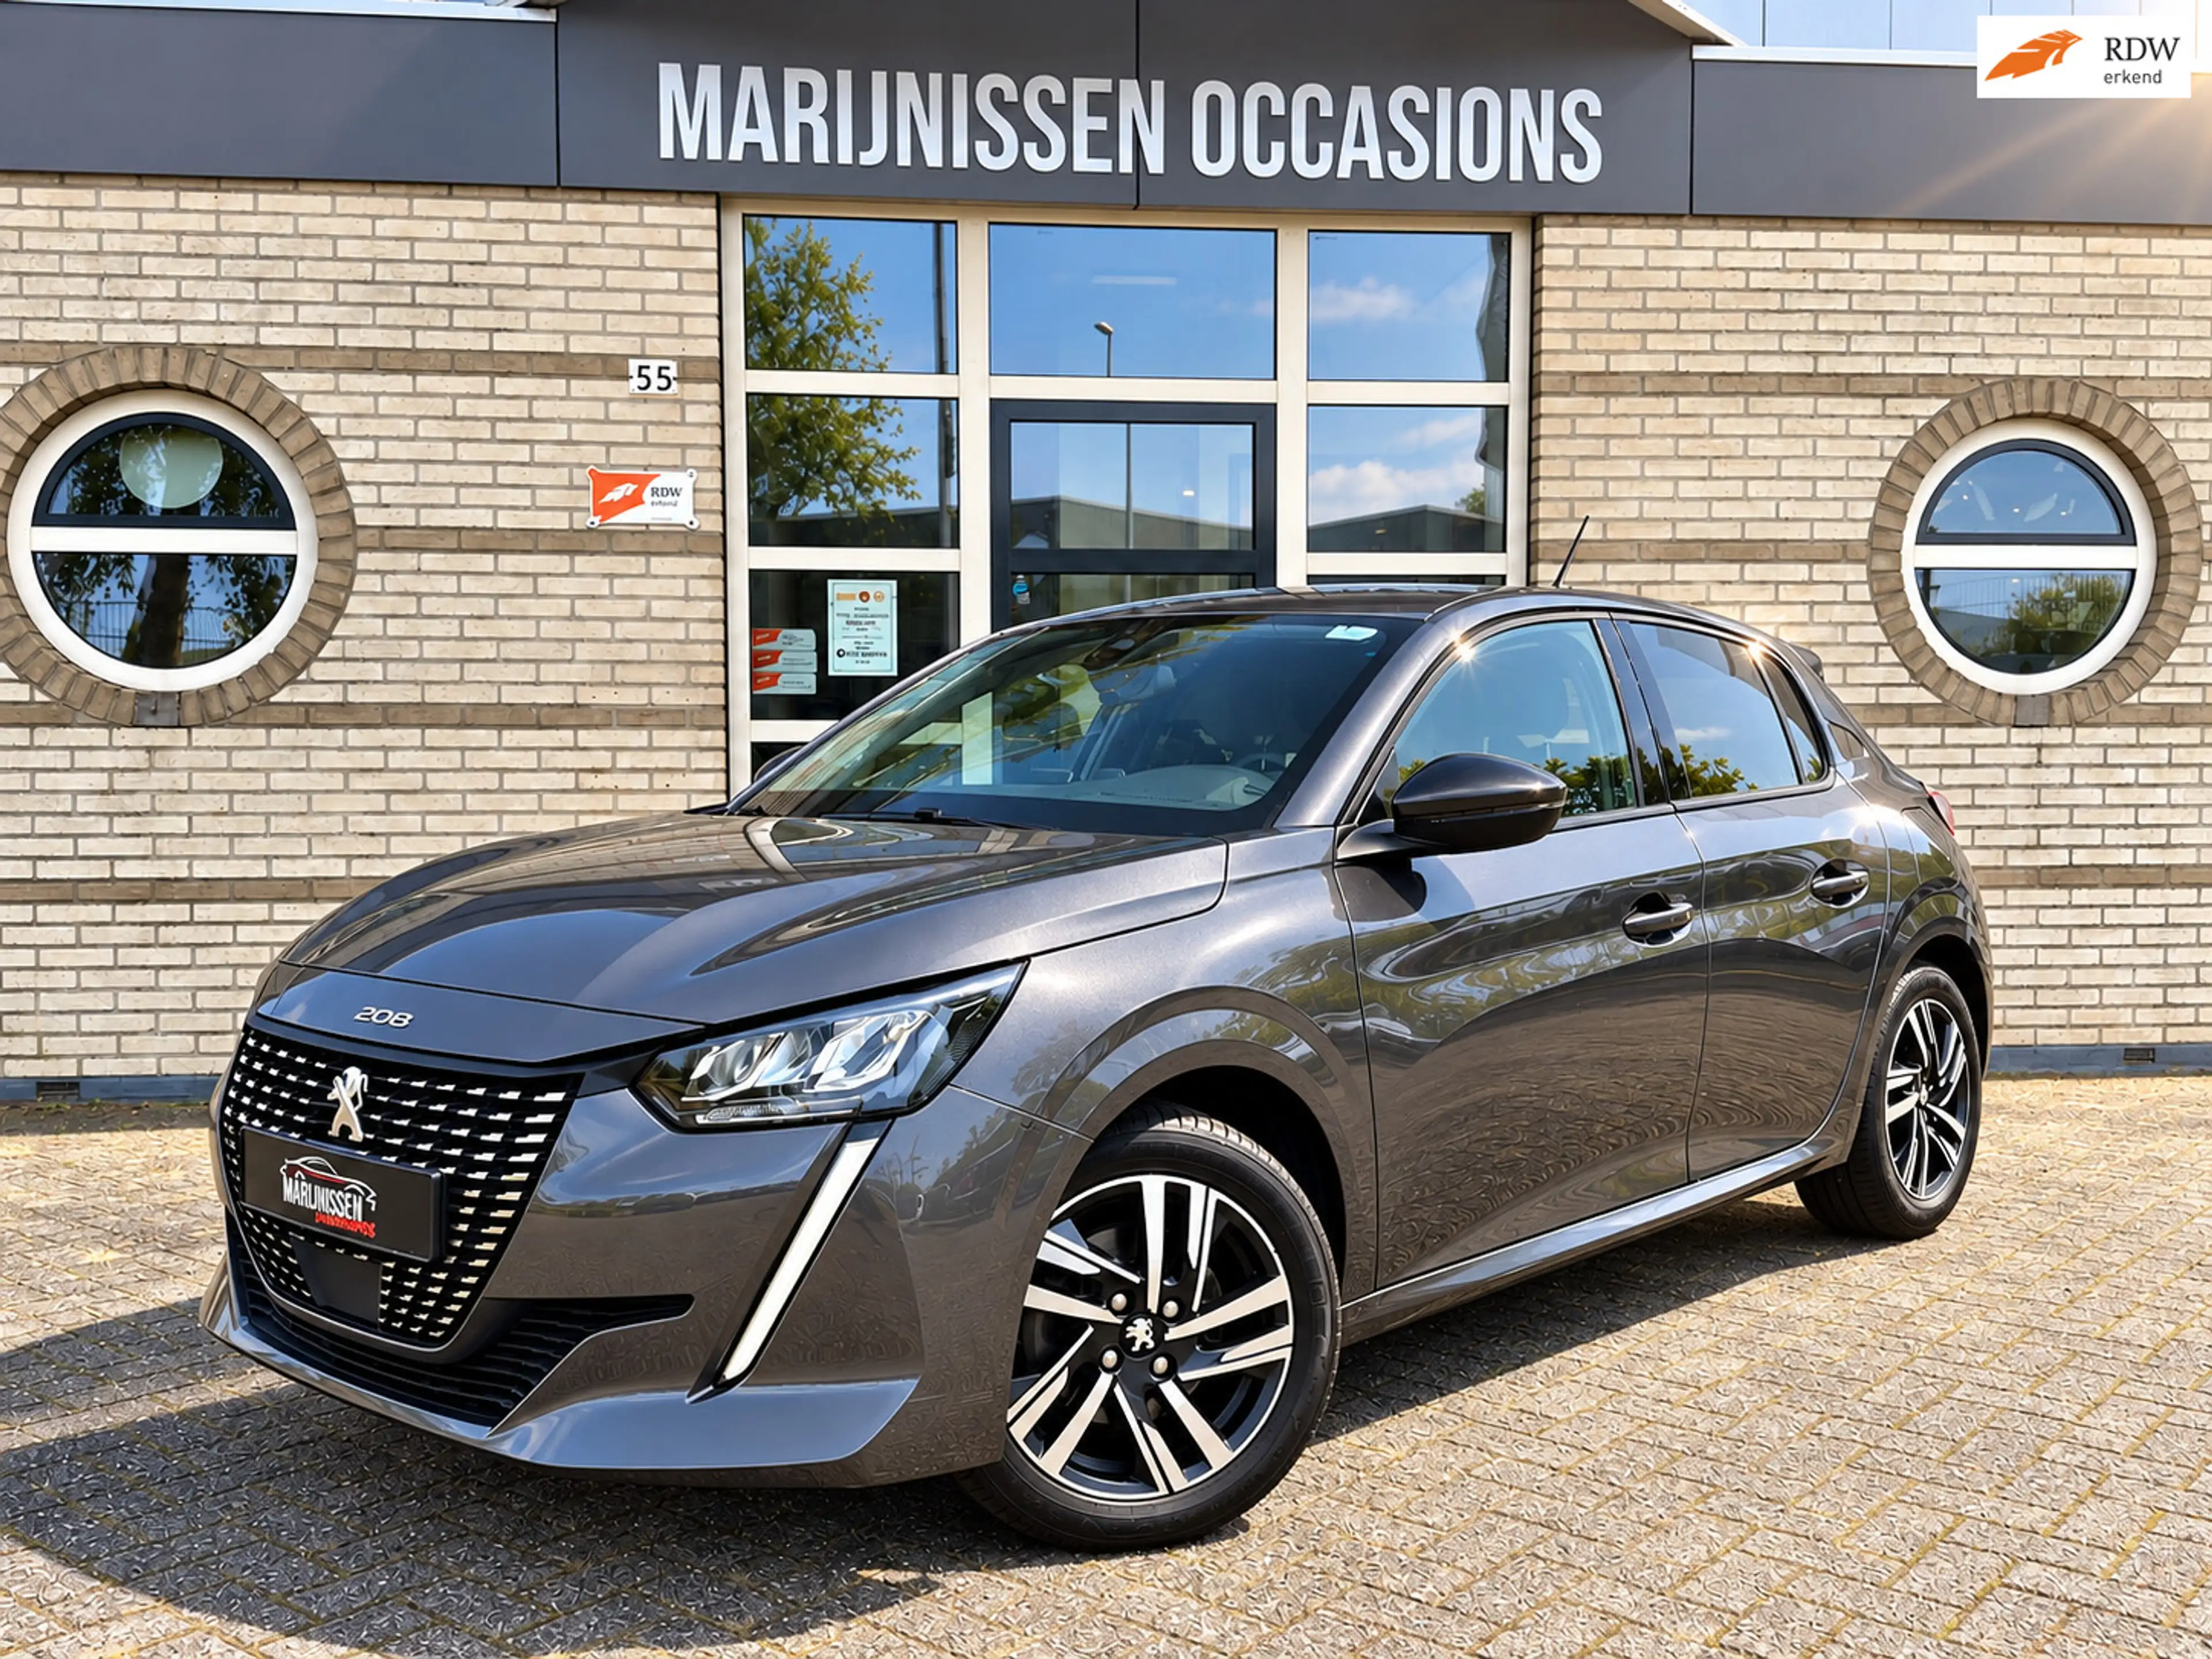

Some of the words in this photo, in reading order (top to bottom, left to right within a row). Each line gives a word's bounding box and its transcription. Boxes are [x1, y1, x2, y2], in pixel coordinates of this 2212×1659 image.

[658, 62, 1164, 175] MARIJNISSEN
[1191, 79, 1603, 184] OCCASIONS
[637, 365, 672, 391] 55
[651, 487, 682, 497] RDW
[354, 1006, 414, 1028] 208
